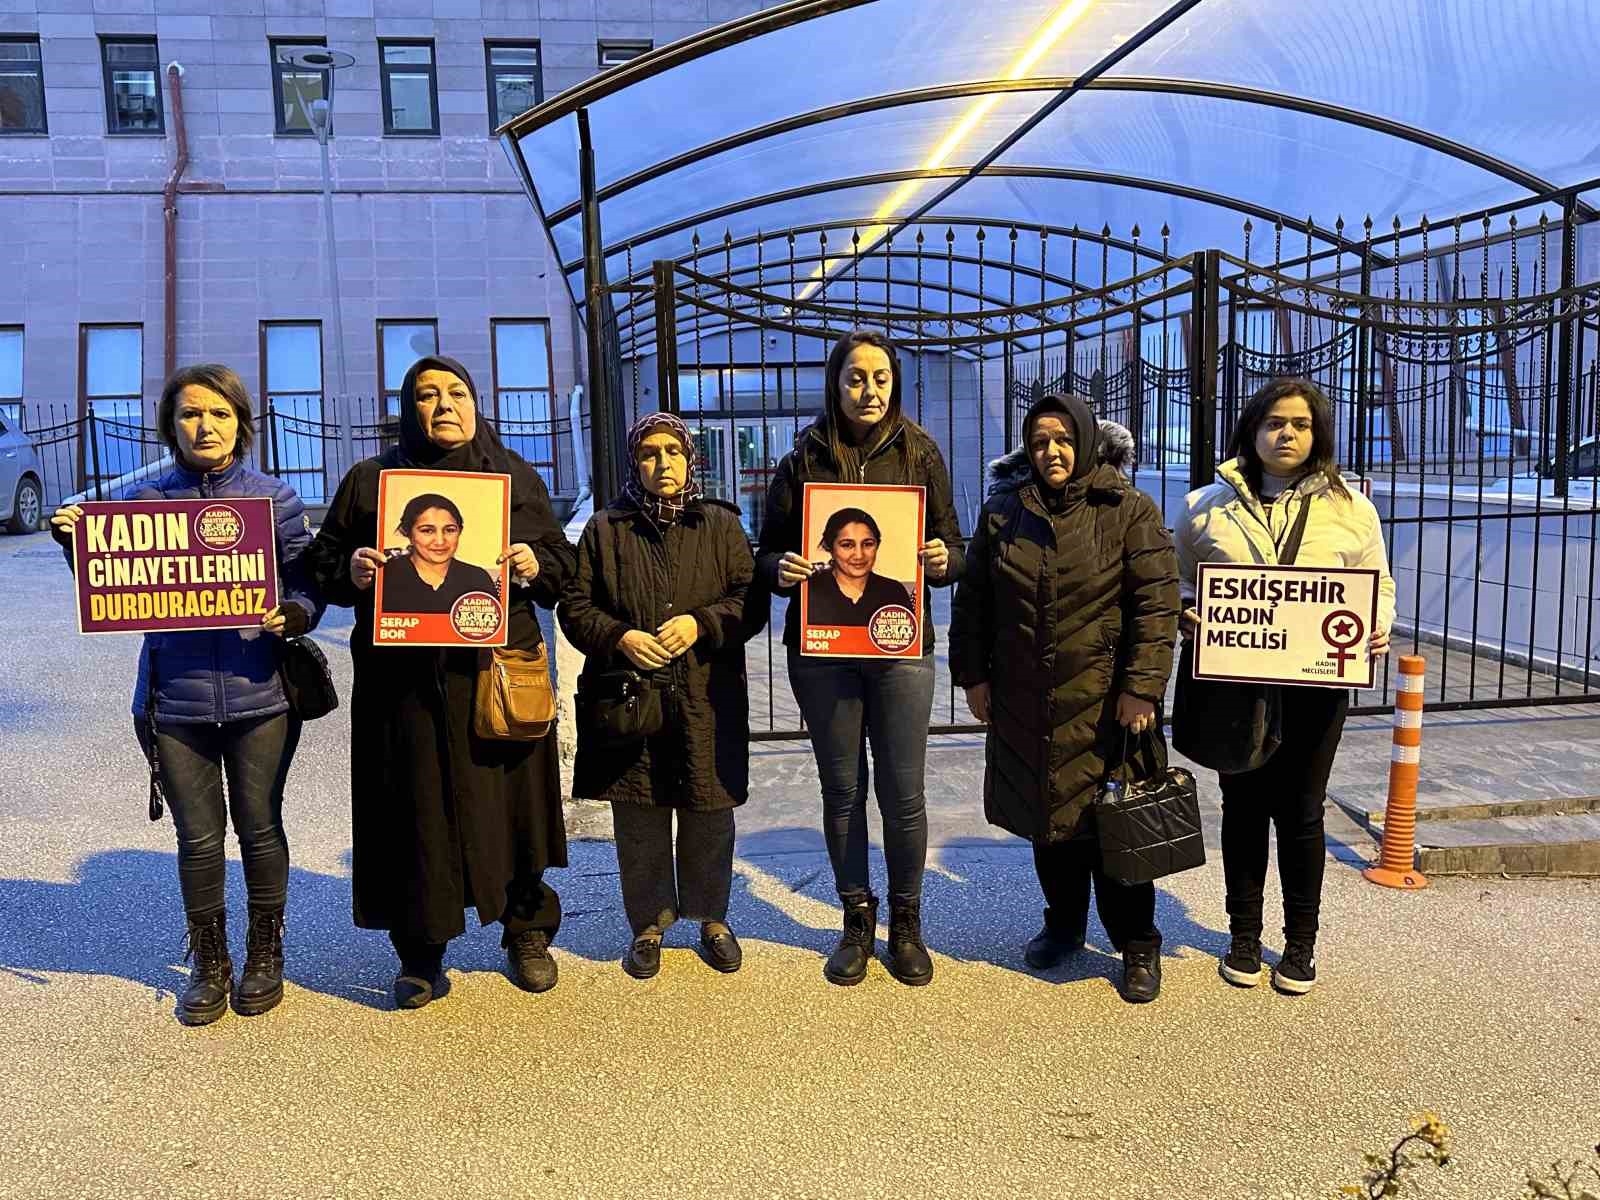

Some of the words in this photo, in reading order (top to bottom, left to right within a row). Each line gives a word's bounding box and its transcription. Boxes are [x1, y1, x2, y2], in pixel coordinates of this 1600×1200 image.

[86, 513, 189, 553] KADIN
[88, 549, 266, 587] CİNAYETLERİNİ
[1208, 573, 1346, 608] ESKİŞEHİR
[90, 583, 267, 621] DURDURACAĞIZ
[463, 598, 492, 606] KADIN
[380, 617, 419, 628] SERAP
[880, 611, 907, 619] KADIN
[1207, 606, 1274, 626] KADIN
[380, 629, 406, 639] BOR
[807, 629, 840, 640] SERAP
[1206, 628, 1287, 650] MECLİSİ
[807, 640, 829, 650] BOR
